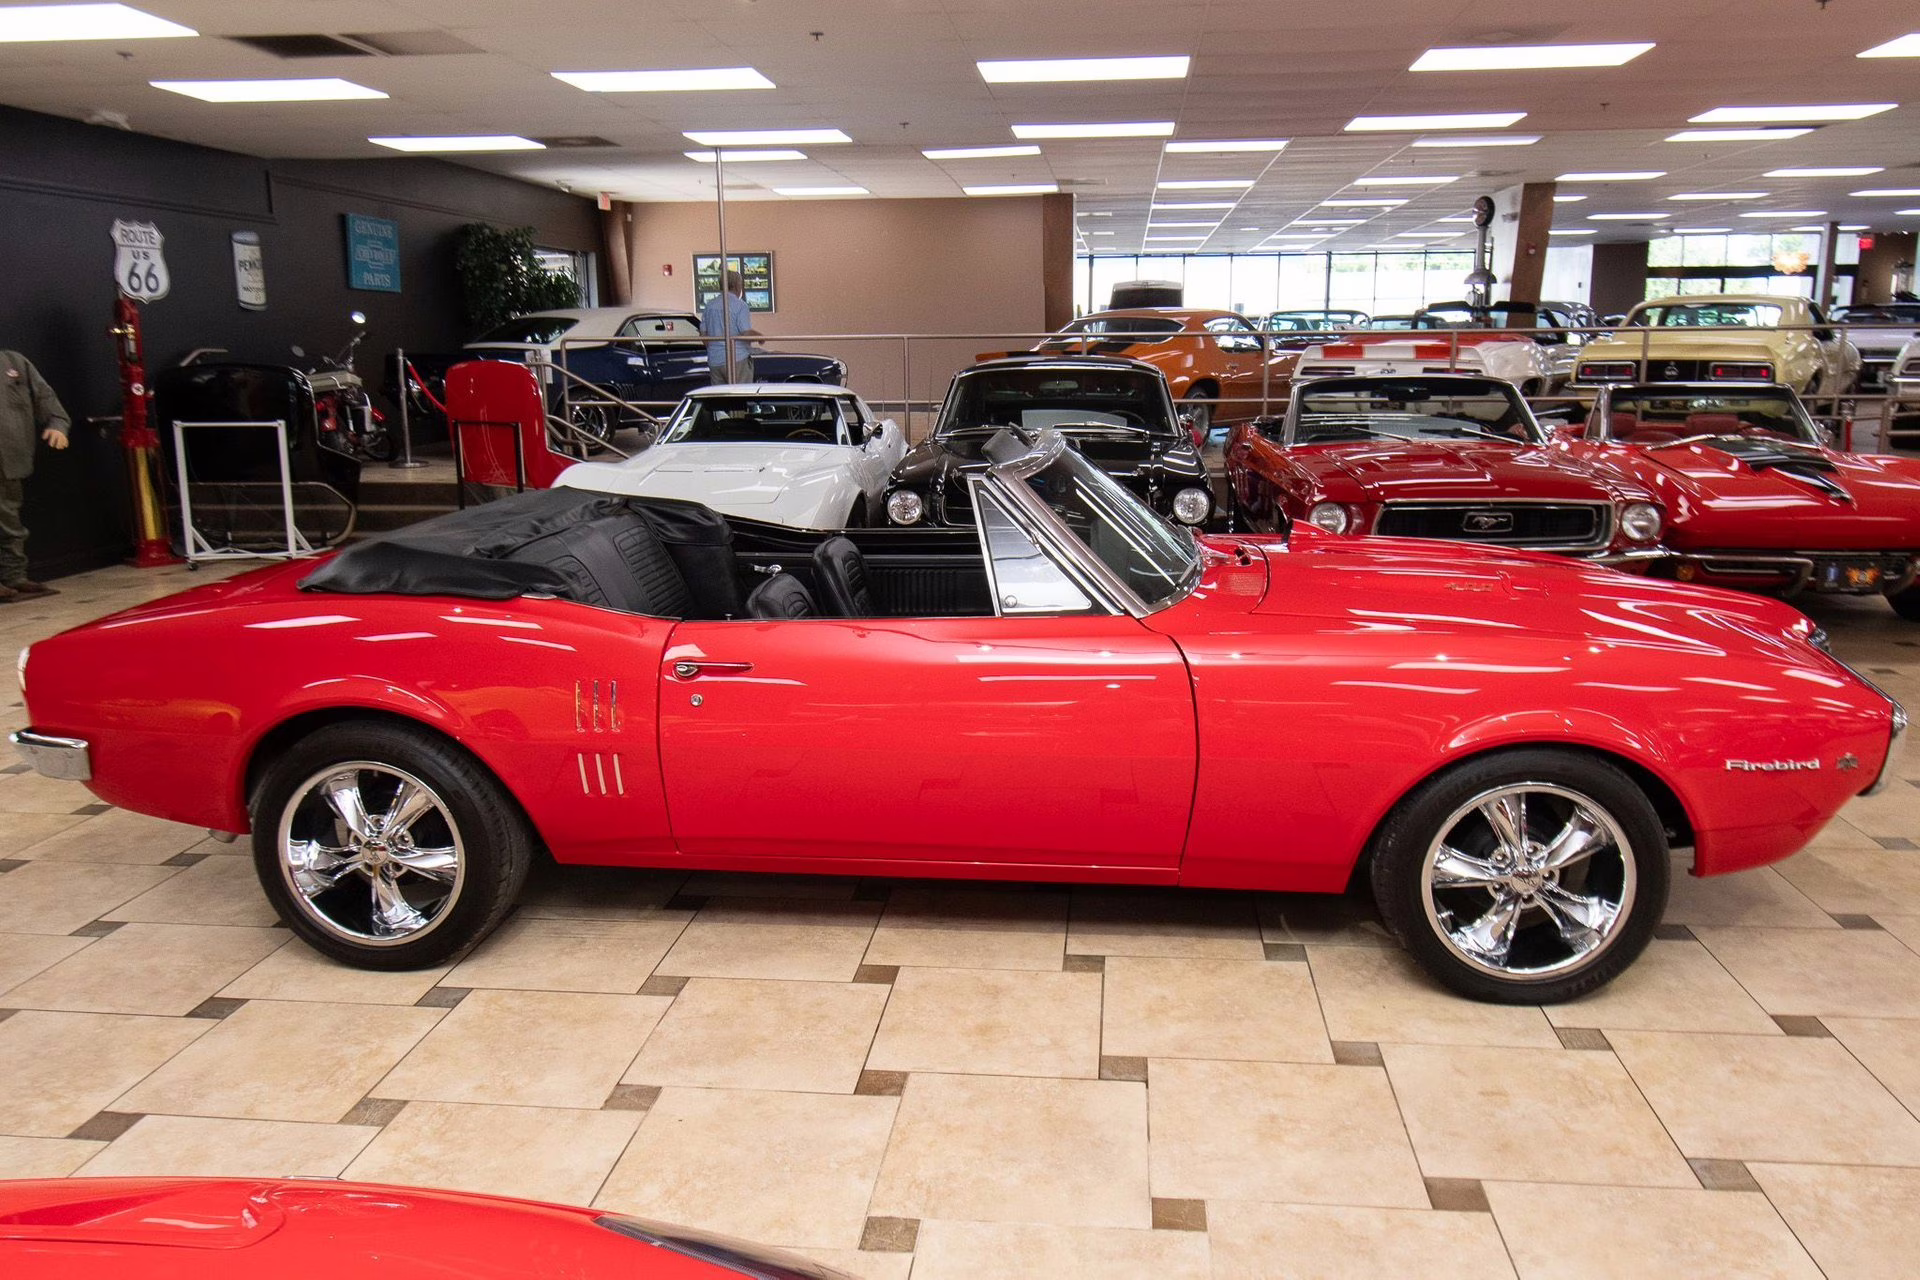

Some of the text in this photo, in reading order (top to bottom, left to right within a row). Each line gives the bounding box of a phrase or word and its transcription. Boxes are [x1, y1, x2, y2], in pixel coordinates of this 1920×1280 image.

[120, 226, 156, 245] ROUTE
[355, 220, 393, 239] GENUINE
[128, 262, 159, 293] 66
[363, 271, 391, 287] PARTS
[1726, 758, 1820, 771] Firebird
